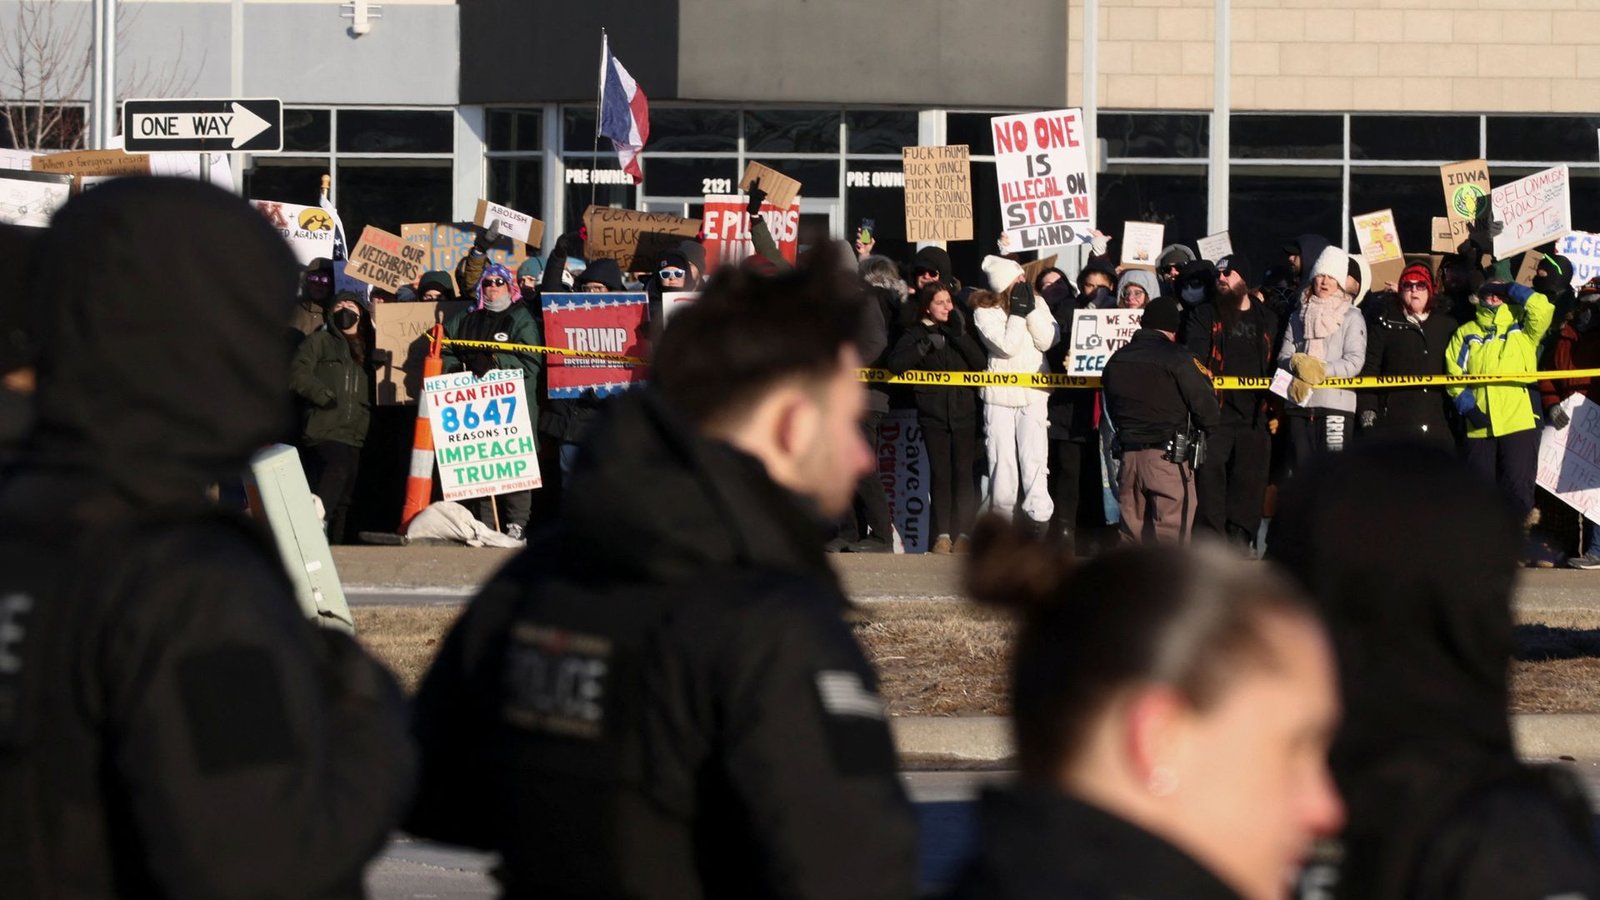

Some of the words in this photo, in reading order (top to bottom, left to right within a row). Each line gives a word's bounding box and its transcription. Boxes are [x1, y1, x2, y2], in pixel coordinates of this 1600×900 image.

[141, 116, 179, 136] ONE
[192, 116, 234, 136] WAY
[994, 120, 1028, 154] NO
[1034, 115, 1080, 150] ONE
[904, 147, 934, 160] FUCK
[937, 146, 969, 159] TRUMP
[904, 163, 931, 176] FUCK
[934, 161, 966, 174] VANCE
[1026, 154, 1052, 178] IS
[565, 169, 589, 184] PRE
[702, 178, 732, 194] 2121
[846, 171, 869, 187] PRE
[871, 171, 906, 187] OWN
[904, 178, 932, 190] FUCK
[934, 175, 967, 191] NOEM
[1447, 170, 1488, 185] IOWA
[905, 191, 933, 204] FUCK
[934, 191, 969, 204] BOVINO
[1002, 176, 1063, 204] ILLEGAL
[1067, 172, 1087, 195] ON
[491, 205, 528, 224] ABOLISH
[906, 205, 933, 218] FUCK
[934, 203, 972, 219] REYNOLDS
[1007, 197, 1089, 227] STOLEN
[500, 220, 514, 232] ICE
[704, 211, 719, 240] E
[603, 227, 641, 247] FUCK
[1021, 224, 1075, 248] LAND
[358, 243, 419, 281] NEIGHBORS
[401, 244, 425, 265] OUR
[356, 262, 401, 289] ALONE
[1106, 315, 1120, 325] WE
[1128, 313, 1143, 325] SA
[564, 327, 627, 353] TRUMP
[1074, 355, 1106, 372] ICE
[426, 380, 448, 391] HEY
[897, 370, 951, 383] CAUTION
[963, 373, 1018, 384] CAUTION
[1031, 375, 1087, 386] CAUTION
[1376, 375, 1433, 384] CAUTION
[434, 394, 440, 407] I
[444, 388, 477, 405] CAN
[481, 381, 516, 399] FIND
[441, 396, 517, 433] 8647
[448, 428, 500, 443] REASONS
[503, 426, 518, 436] TO
[438, 435, 533, 465] IMPEACH
[905, 425, 923, 491] Save
[453, 460, 528, 485] TRUMP
[475, 486, 497, 495] YOUR
[905, 496, 924, 548] Our
